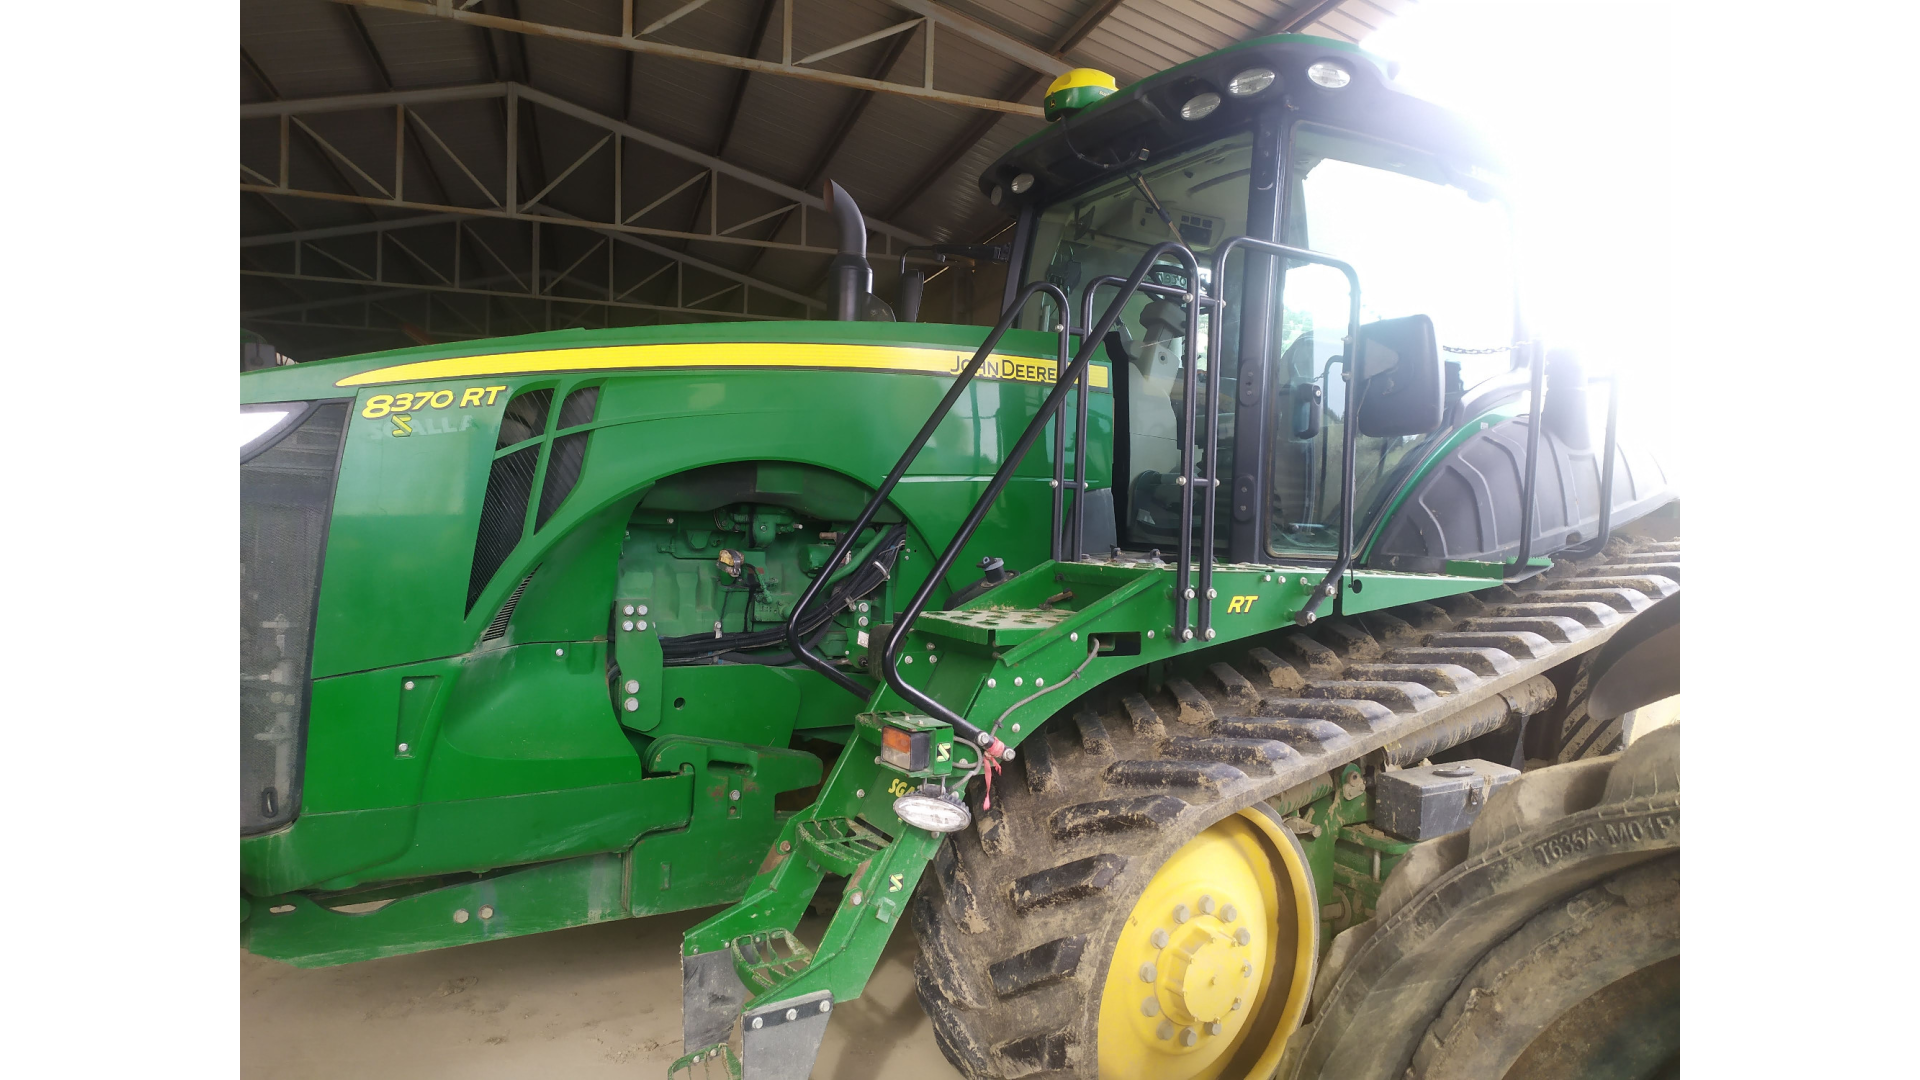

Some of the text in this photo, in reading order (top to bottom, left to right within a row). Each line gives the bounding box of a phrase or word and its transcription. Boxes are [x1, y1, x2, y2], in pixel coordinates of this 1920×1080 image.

[1002, 359, 1057, 382] DEERE
[361, 385, 508, 420] 8370 RT
[1227, 595, 1259, 614] RT
